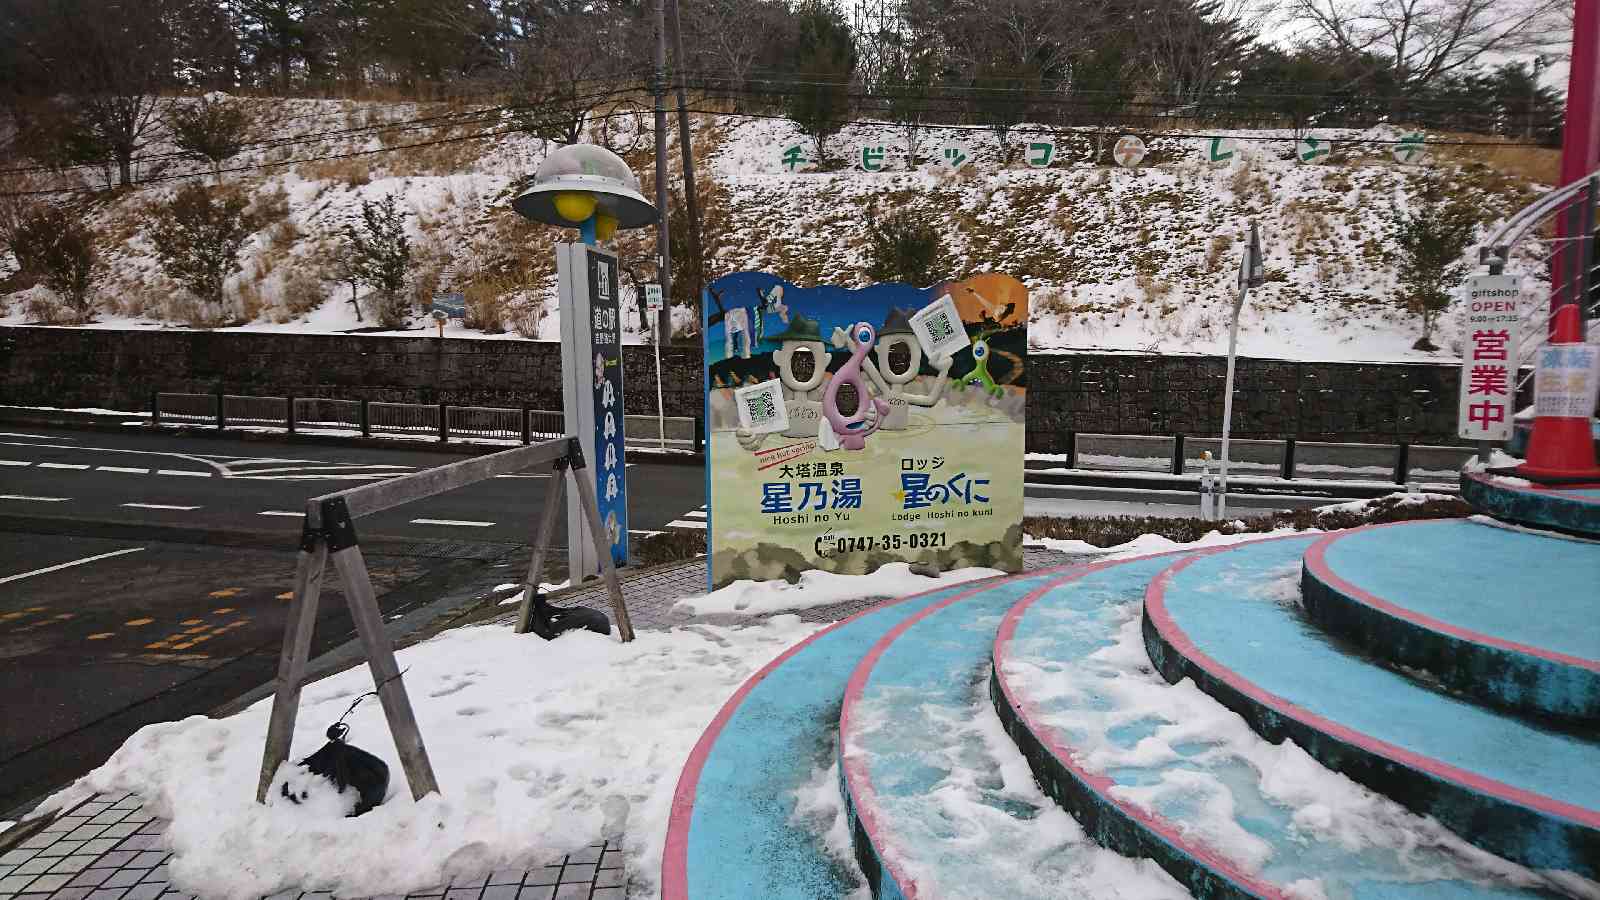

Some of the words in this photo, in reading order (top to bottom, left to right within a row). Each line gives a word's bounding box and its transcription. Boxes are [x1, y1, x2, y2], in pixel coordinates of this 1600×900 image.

[1471, 288, 1519, 299] giftshop
[1471, 301, 1516, 312] OPEN
[594, 306, 616, 330] 道の駅
[1468, 329, 1510, 431] 営業中
[779, 462, 844, 479] 大塔温泉
[901, 456, 945, 471] ロッジ
[760, 478, 863, 514] 星乃湯
[900, 472, 990, 510] 星のくに
[773, 514, 809, 525] Hoshi
[814, 514, 829, 522] no
[834, 512, 850, 521] Yu
[892, 512, 921, 522] Lodge
[927, 510, 954, 519] Hoshi
[837, 532, 946, 554] 0747-35-0321
